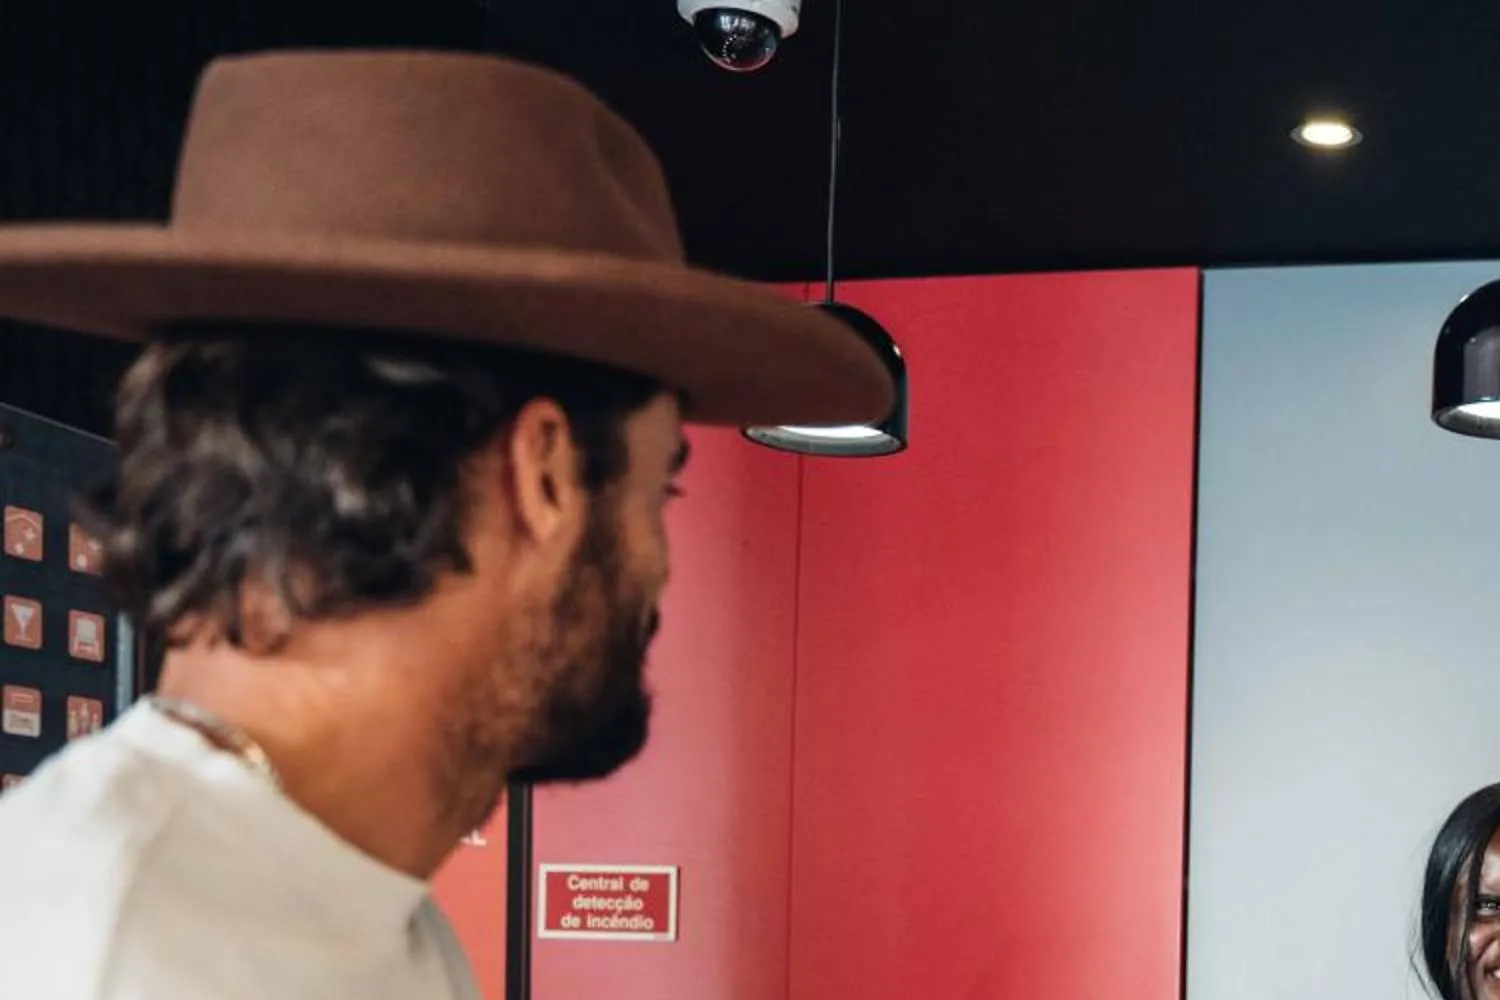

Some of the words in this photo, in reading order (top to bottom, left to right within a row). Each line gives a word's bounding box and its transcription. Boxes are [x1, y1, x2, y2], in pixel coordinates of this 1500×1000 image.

[567, 874, 624, 891] Central
[629, 877, 650, 892] de
[572, 894, 644, 913] detecção
[561, 912, 581, 928] de
